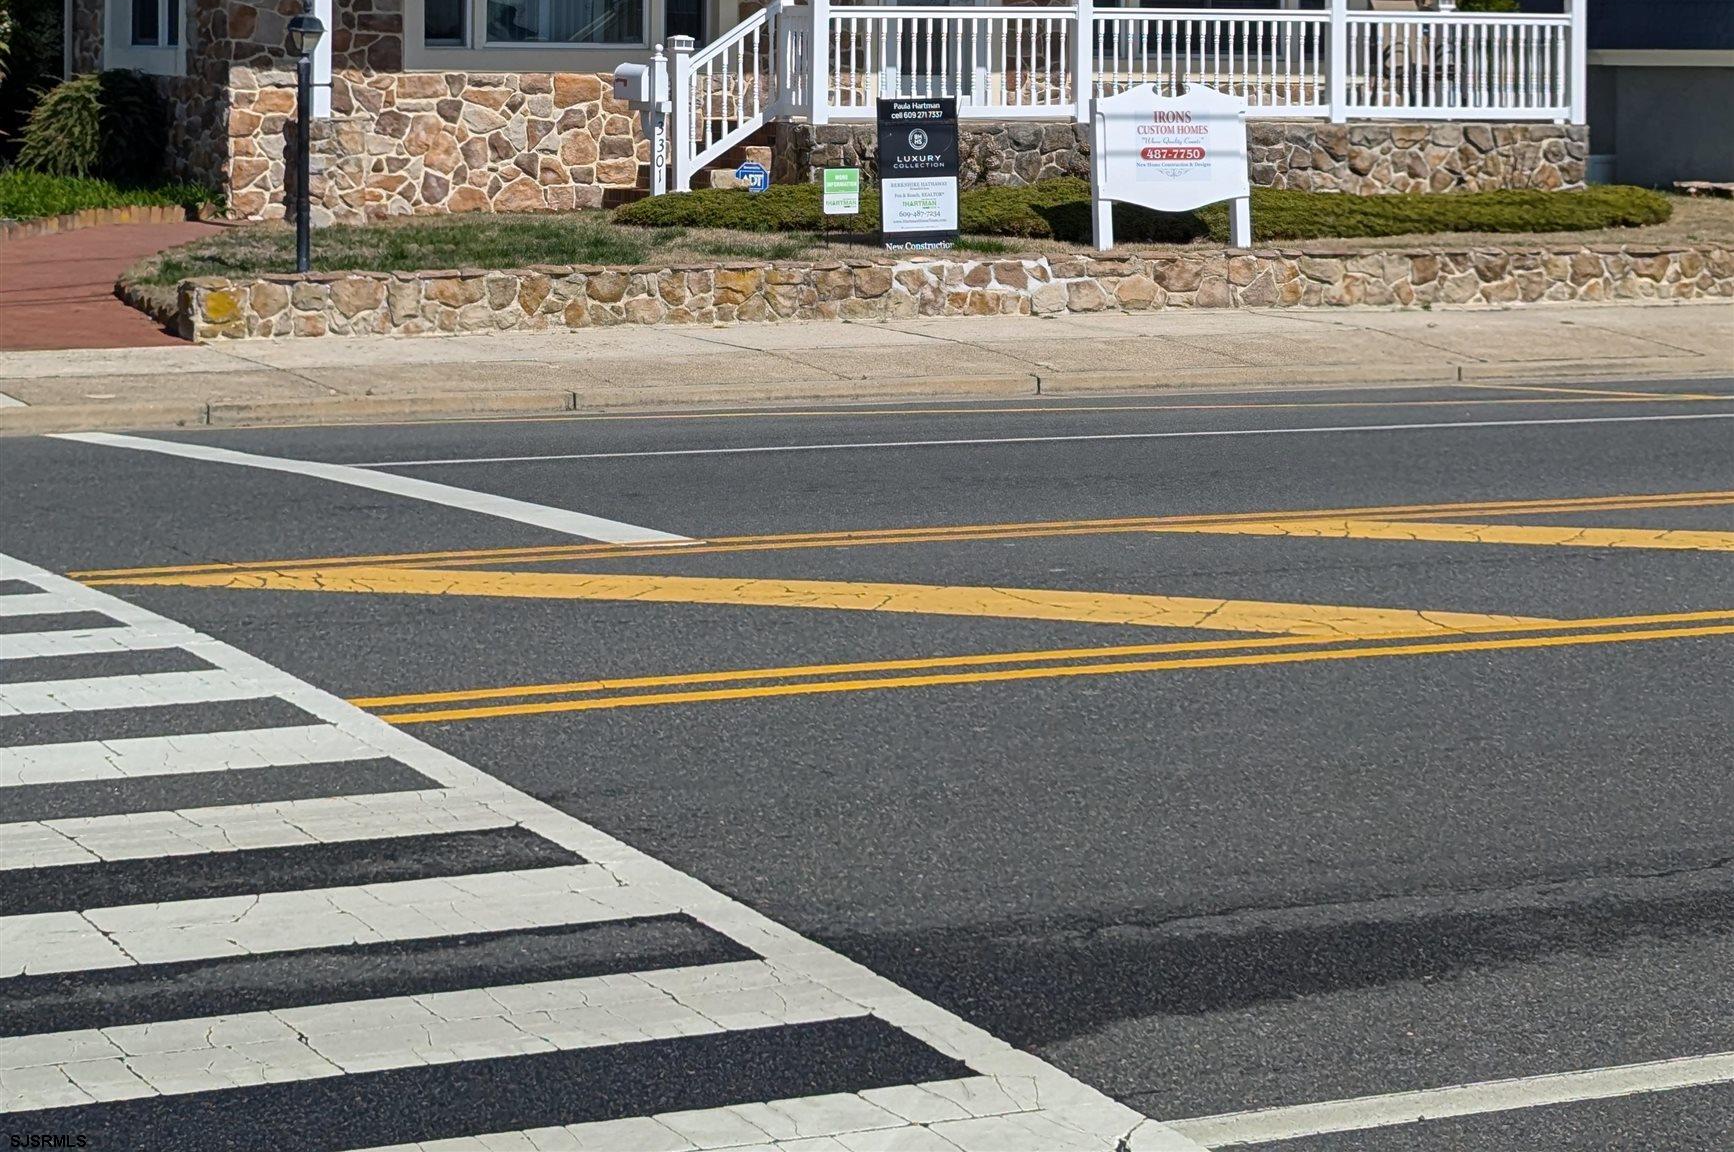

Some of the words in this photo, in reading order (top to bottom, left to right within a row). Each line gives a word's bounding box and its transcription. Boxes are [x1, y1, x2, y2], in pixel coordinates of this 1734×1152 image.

[1153, 110, 1192, 123] IRONS
[1137, 125, 1175, 135] CUSTOM
[1177, 125, 1209, 135] HOMES
[1162, 136, 1183, 145] Quality
[656, 121, 664, 183] 3301
[1147, 149, 1200, 159] 487-7750
[897, 154, 941, 163] LUXURY
[899, 210, 941, 218] 609-487-7234
[885, 242, 904, 250] New
